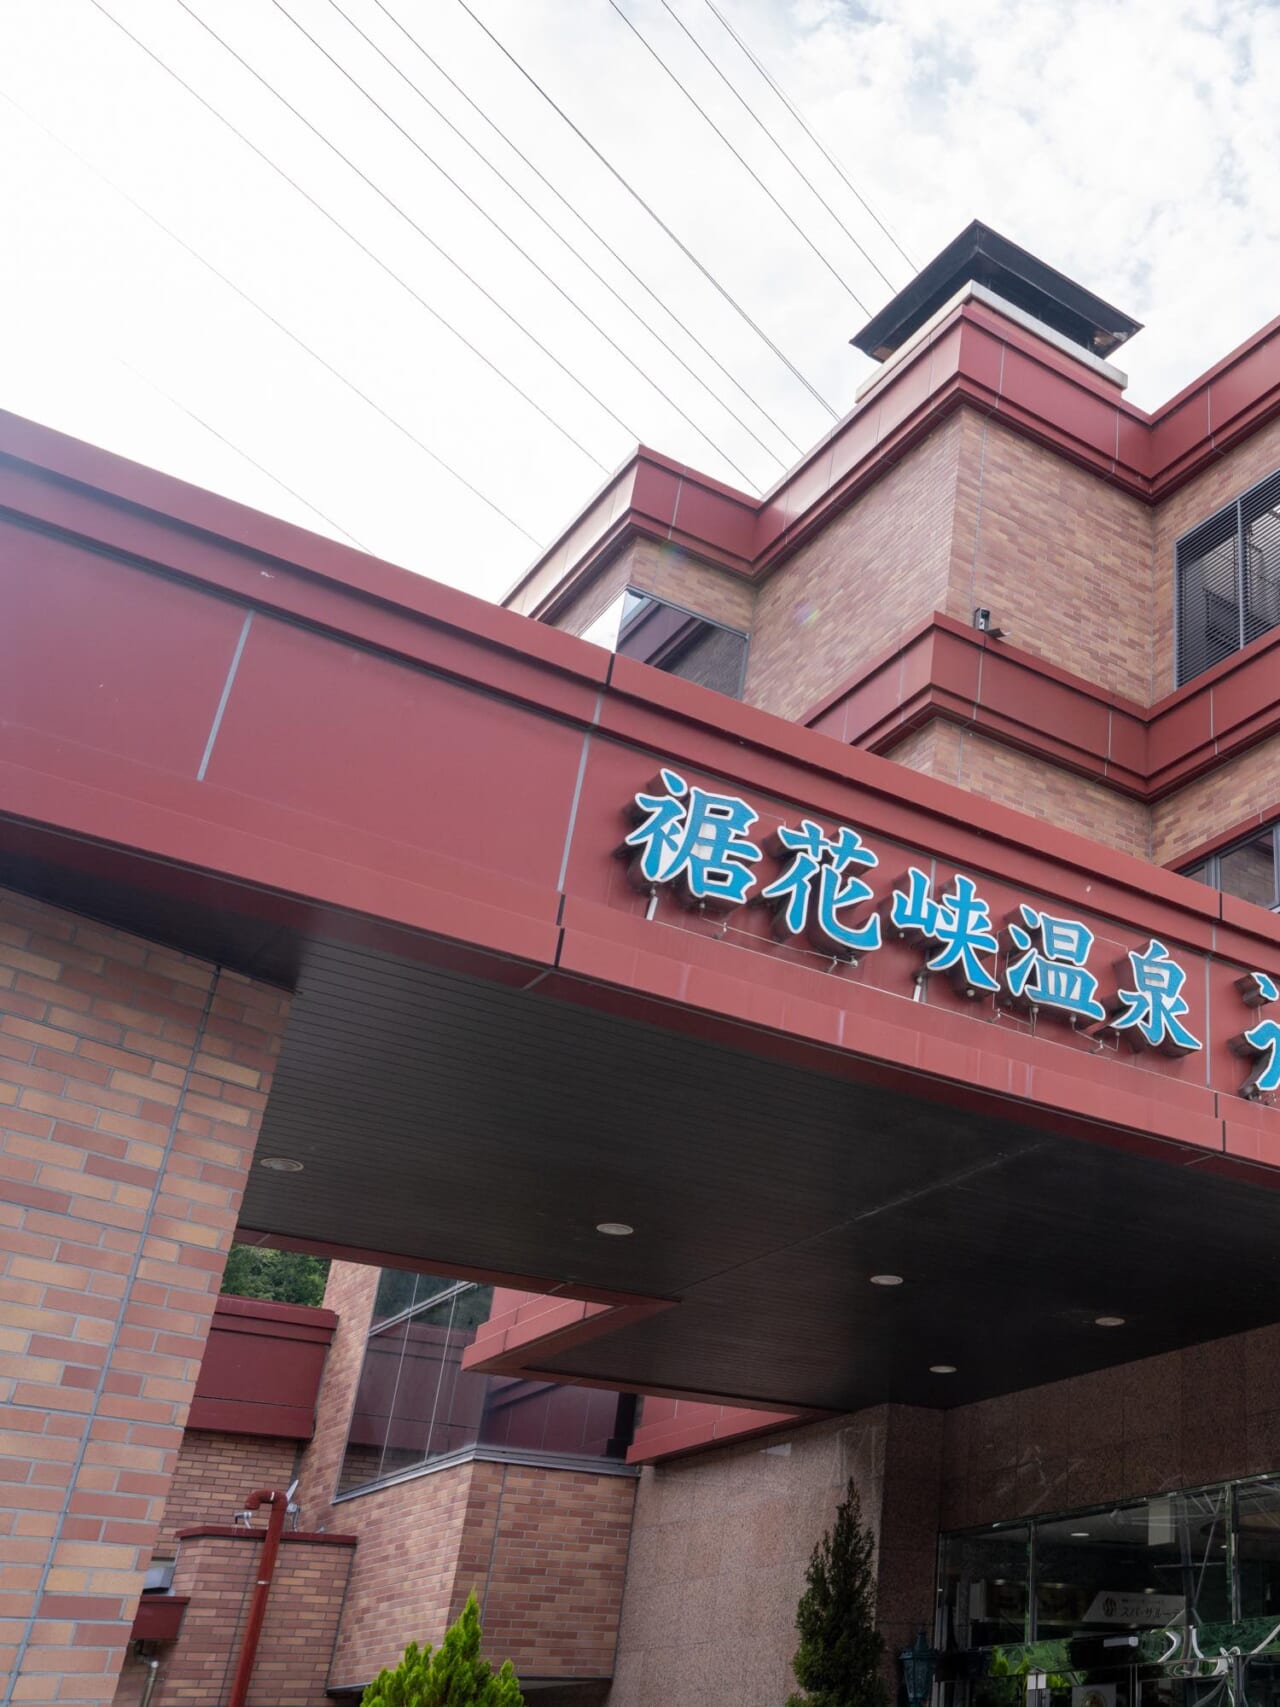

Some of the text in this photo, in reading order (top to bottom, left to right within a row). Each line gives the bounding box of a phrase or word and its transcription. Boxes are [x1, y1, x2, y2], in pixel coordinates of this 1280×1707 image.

[626, 768, 1202, 1050] 裾花峡温泉
